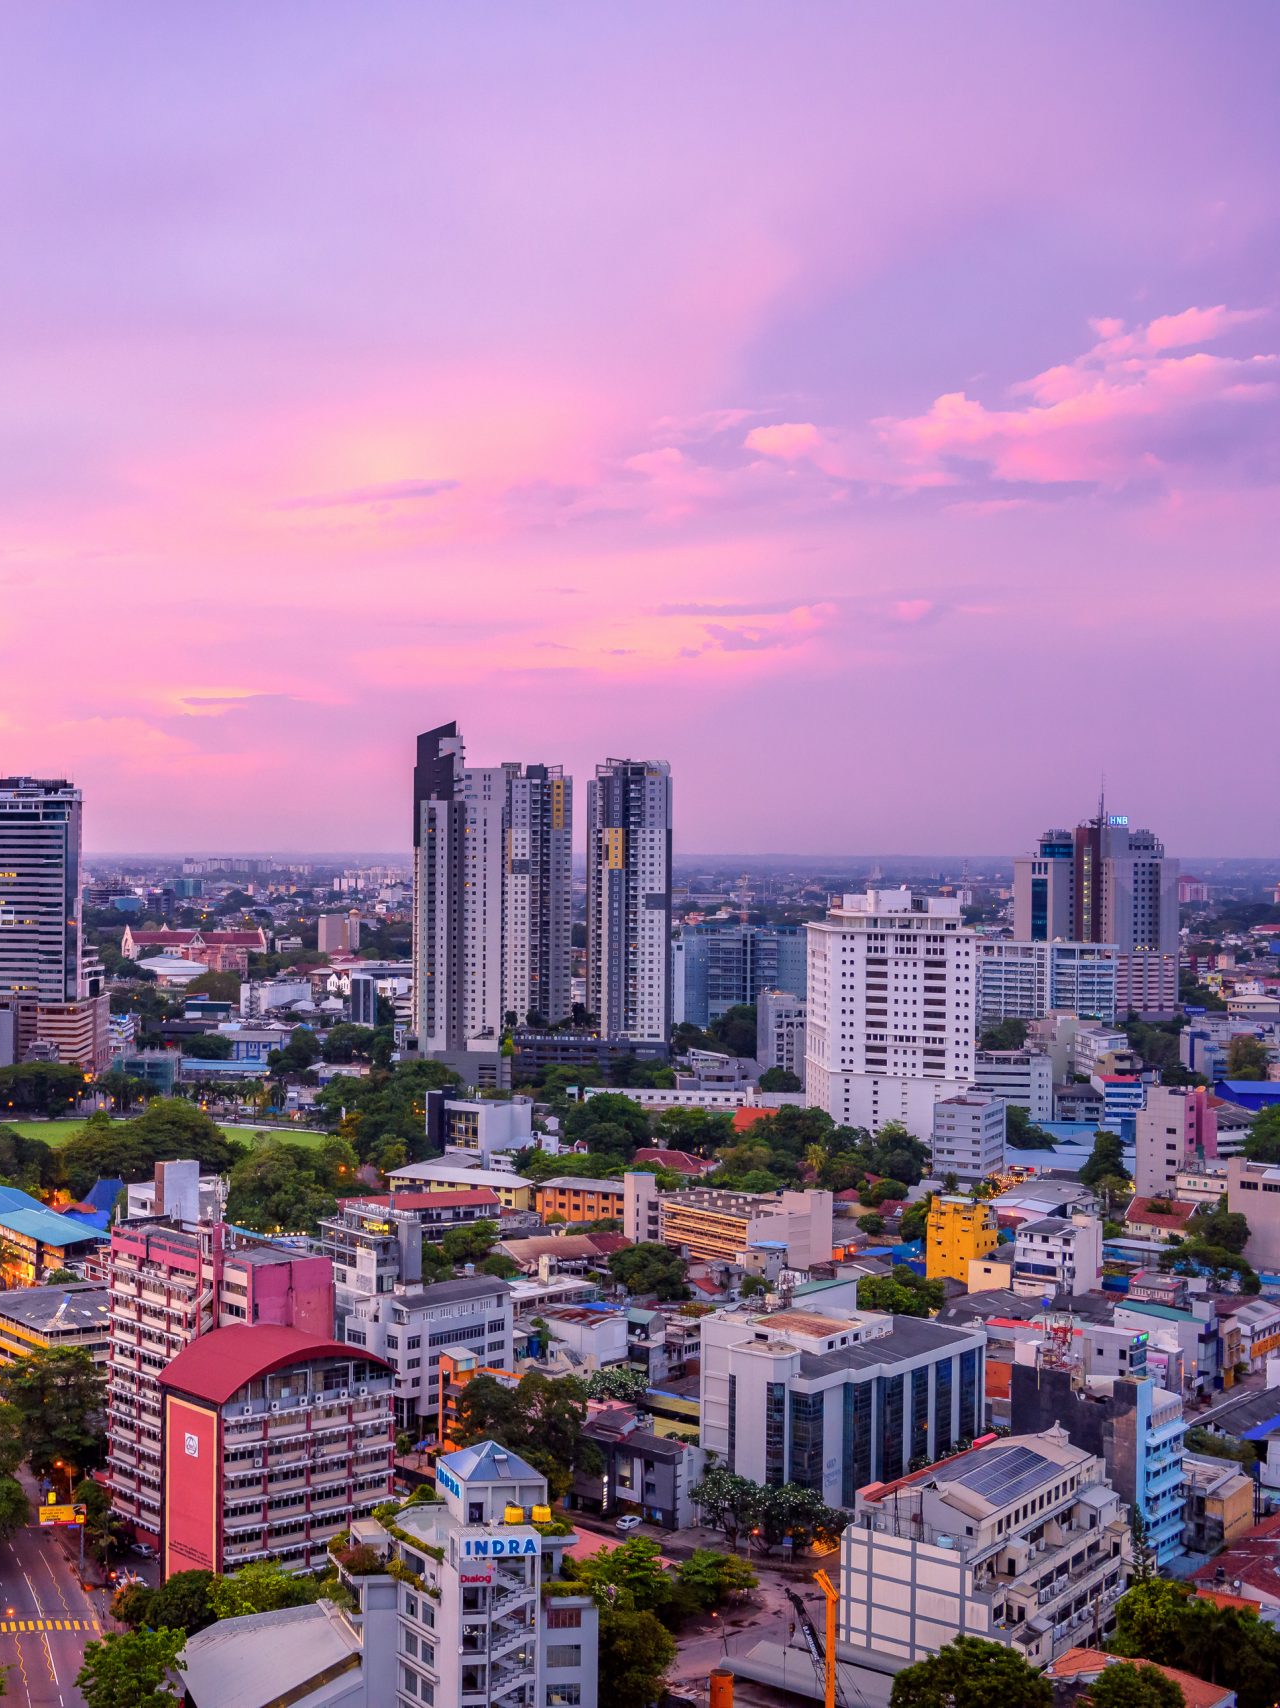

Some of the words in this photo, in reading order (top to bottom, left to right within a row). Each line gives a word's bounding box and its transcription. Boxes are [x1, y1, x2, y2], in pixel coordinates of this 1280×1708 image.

[1110, 816, 1128, 825] HNB
[436, 1465, 461, 1499] INDRA
[465, 1538, 537, 1556] INDRA
[460, 1574, 492, 1584] Dialog
